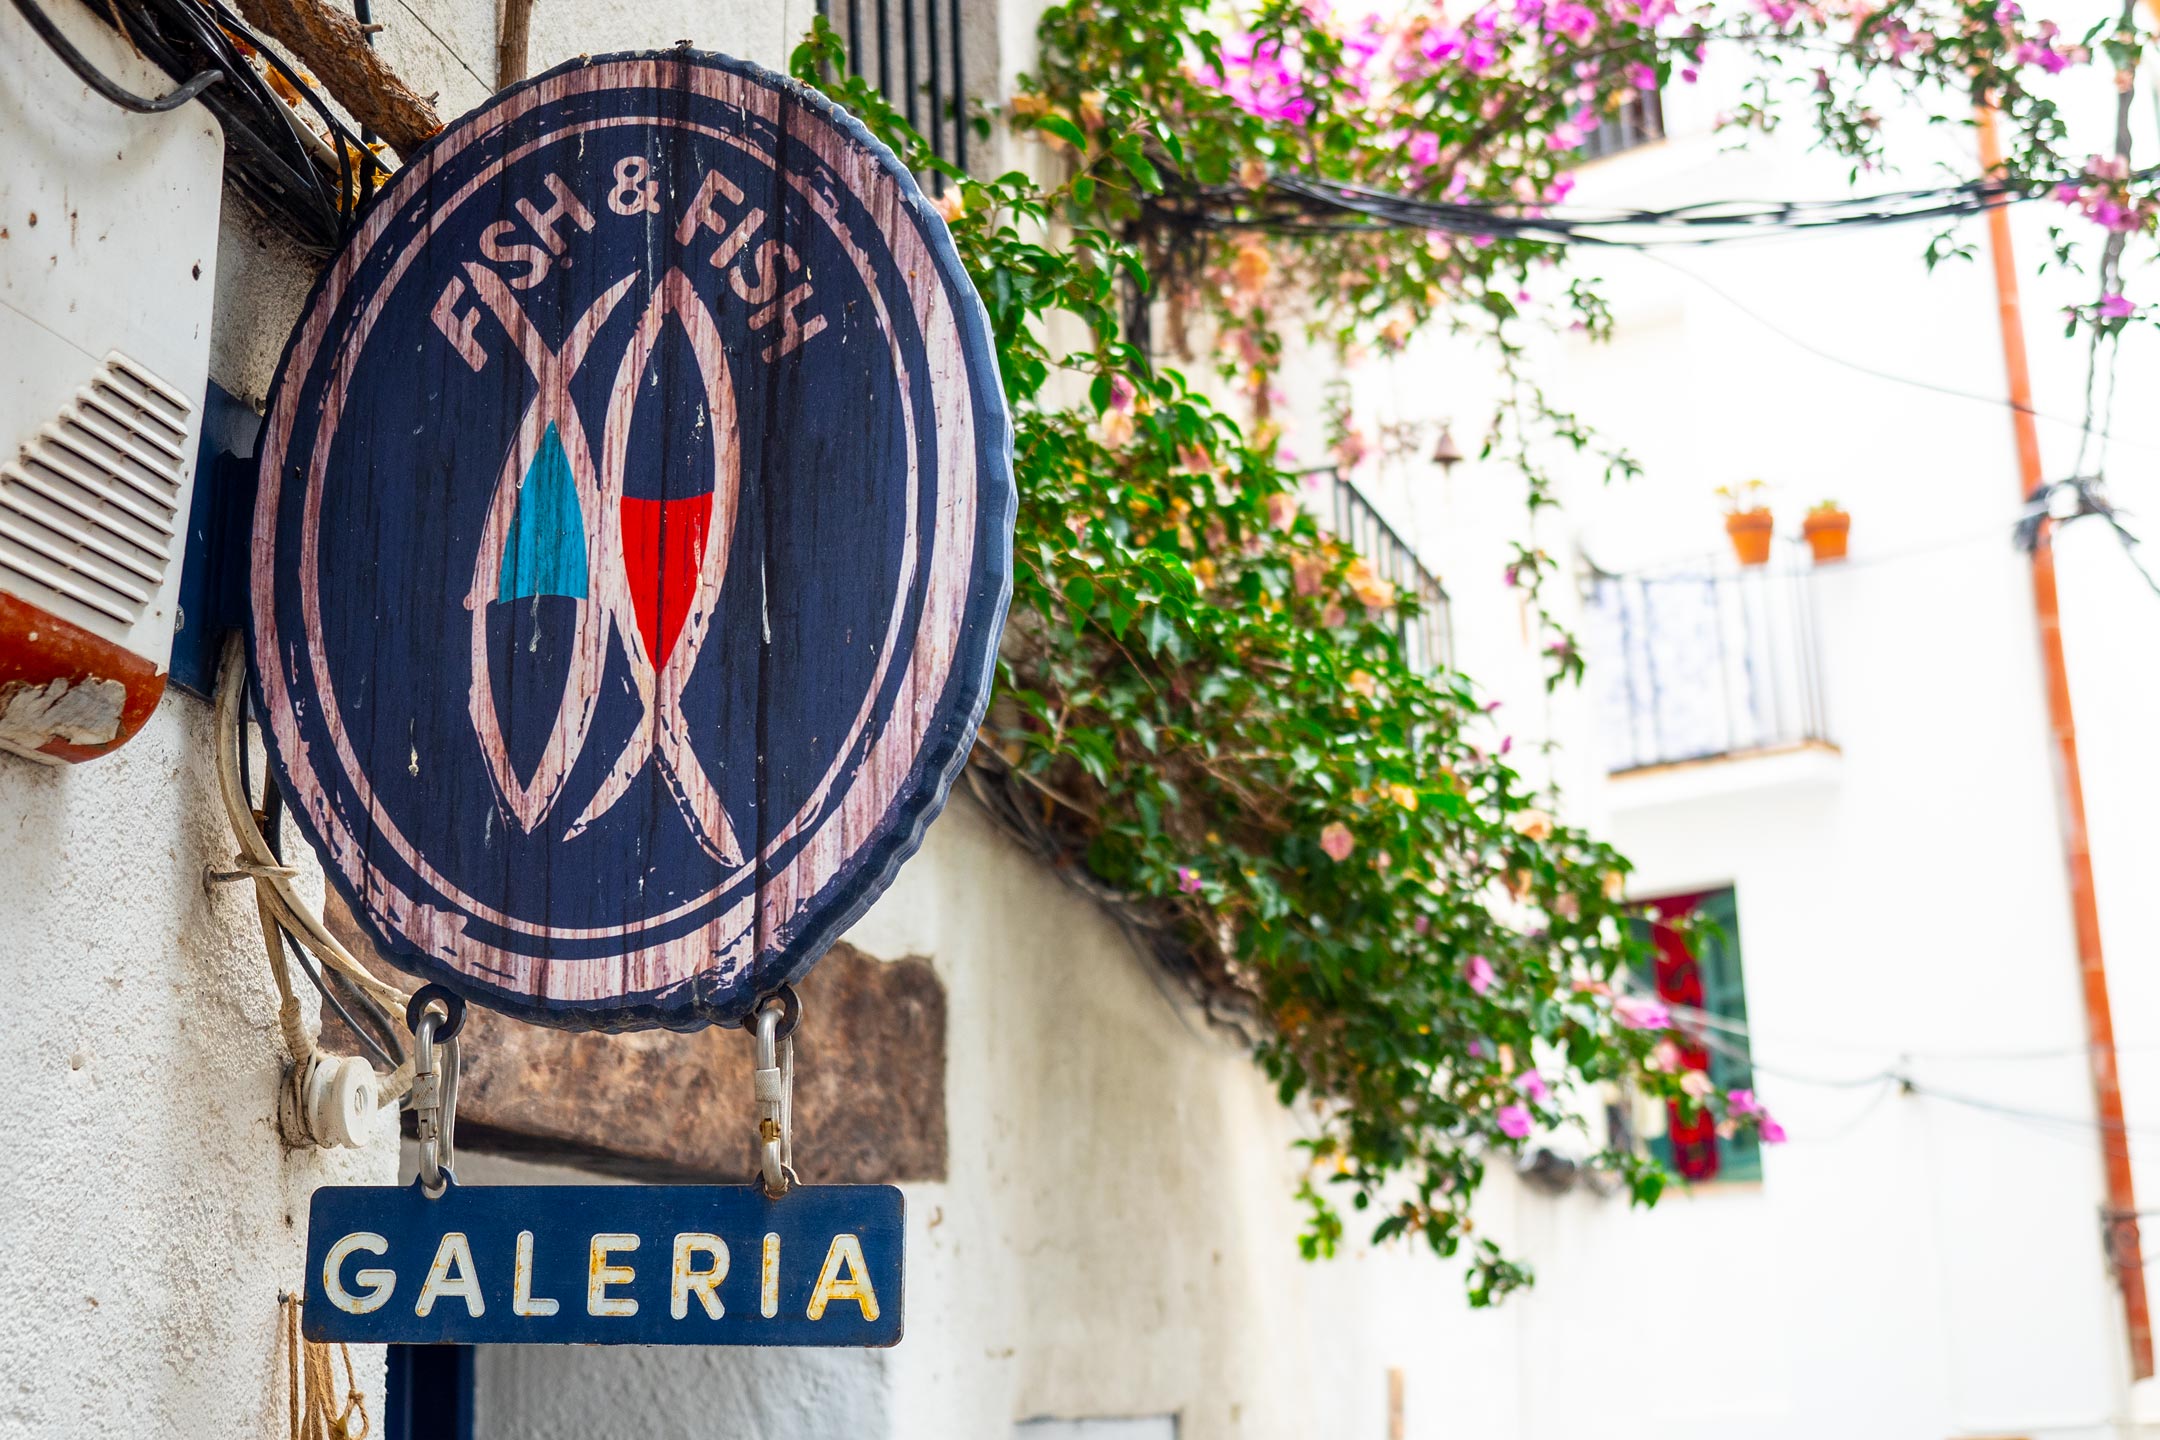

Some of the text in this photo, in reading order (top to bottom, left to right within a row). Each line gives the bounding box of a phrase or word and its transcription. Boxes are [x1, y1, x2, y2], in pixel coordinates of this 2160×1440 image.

[607, 155, 661, 216] &
[674, 168, 829, 364] FISH
[323, 1230, 880, 1322] GALERIA
